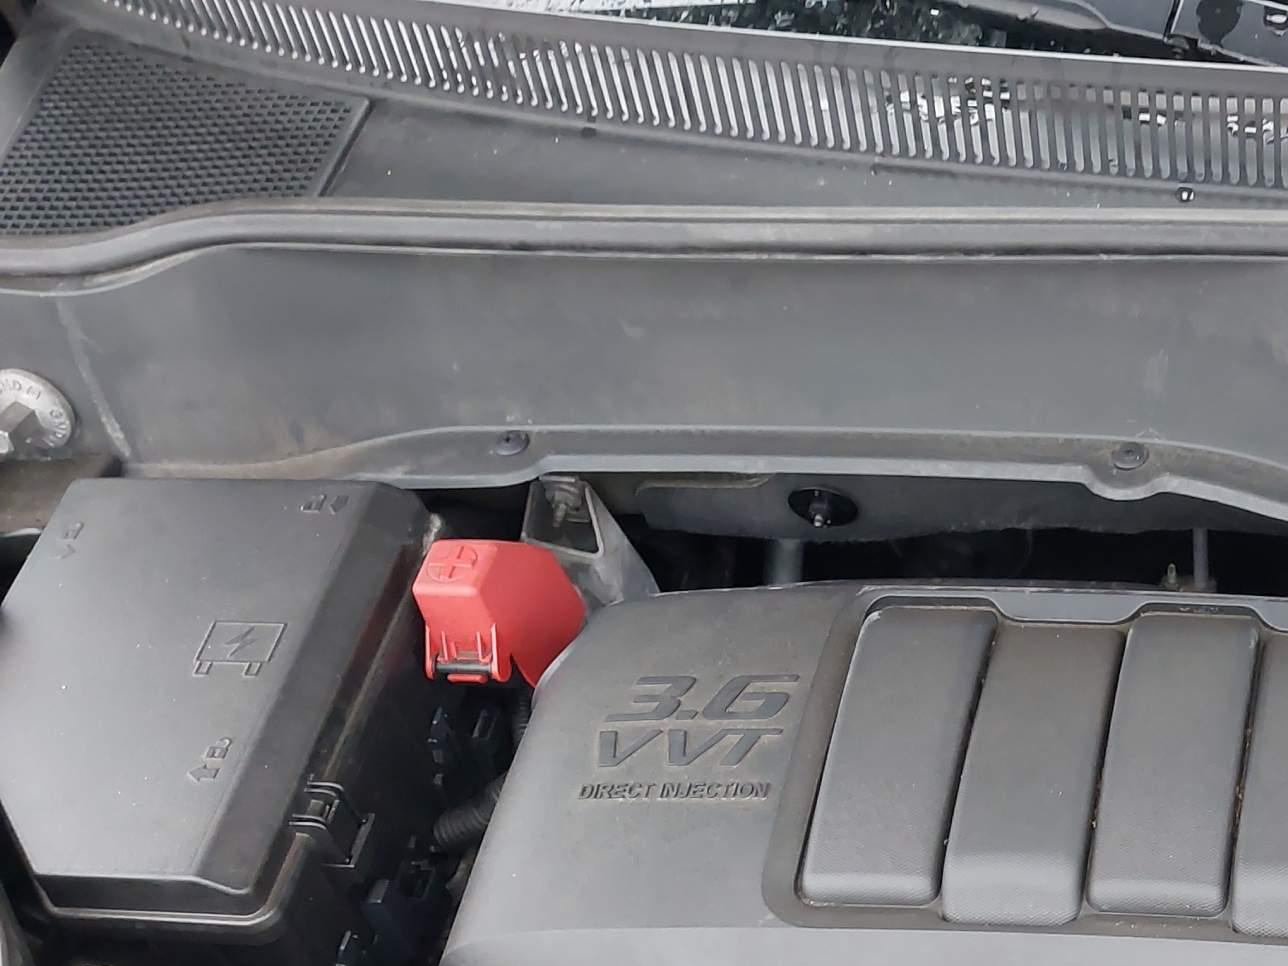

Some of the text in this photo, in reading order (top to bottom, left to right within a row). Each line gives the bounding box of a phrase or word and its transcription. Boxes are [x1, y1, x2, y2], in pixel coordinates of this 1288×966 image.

[604, 674, 800, 722] 3.6
[598, 727, 784, 768] VVT
[578, 782, 772, 800] DIRECT INJECTION
